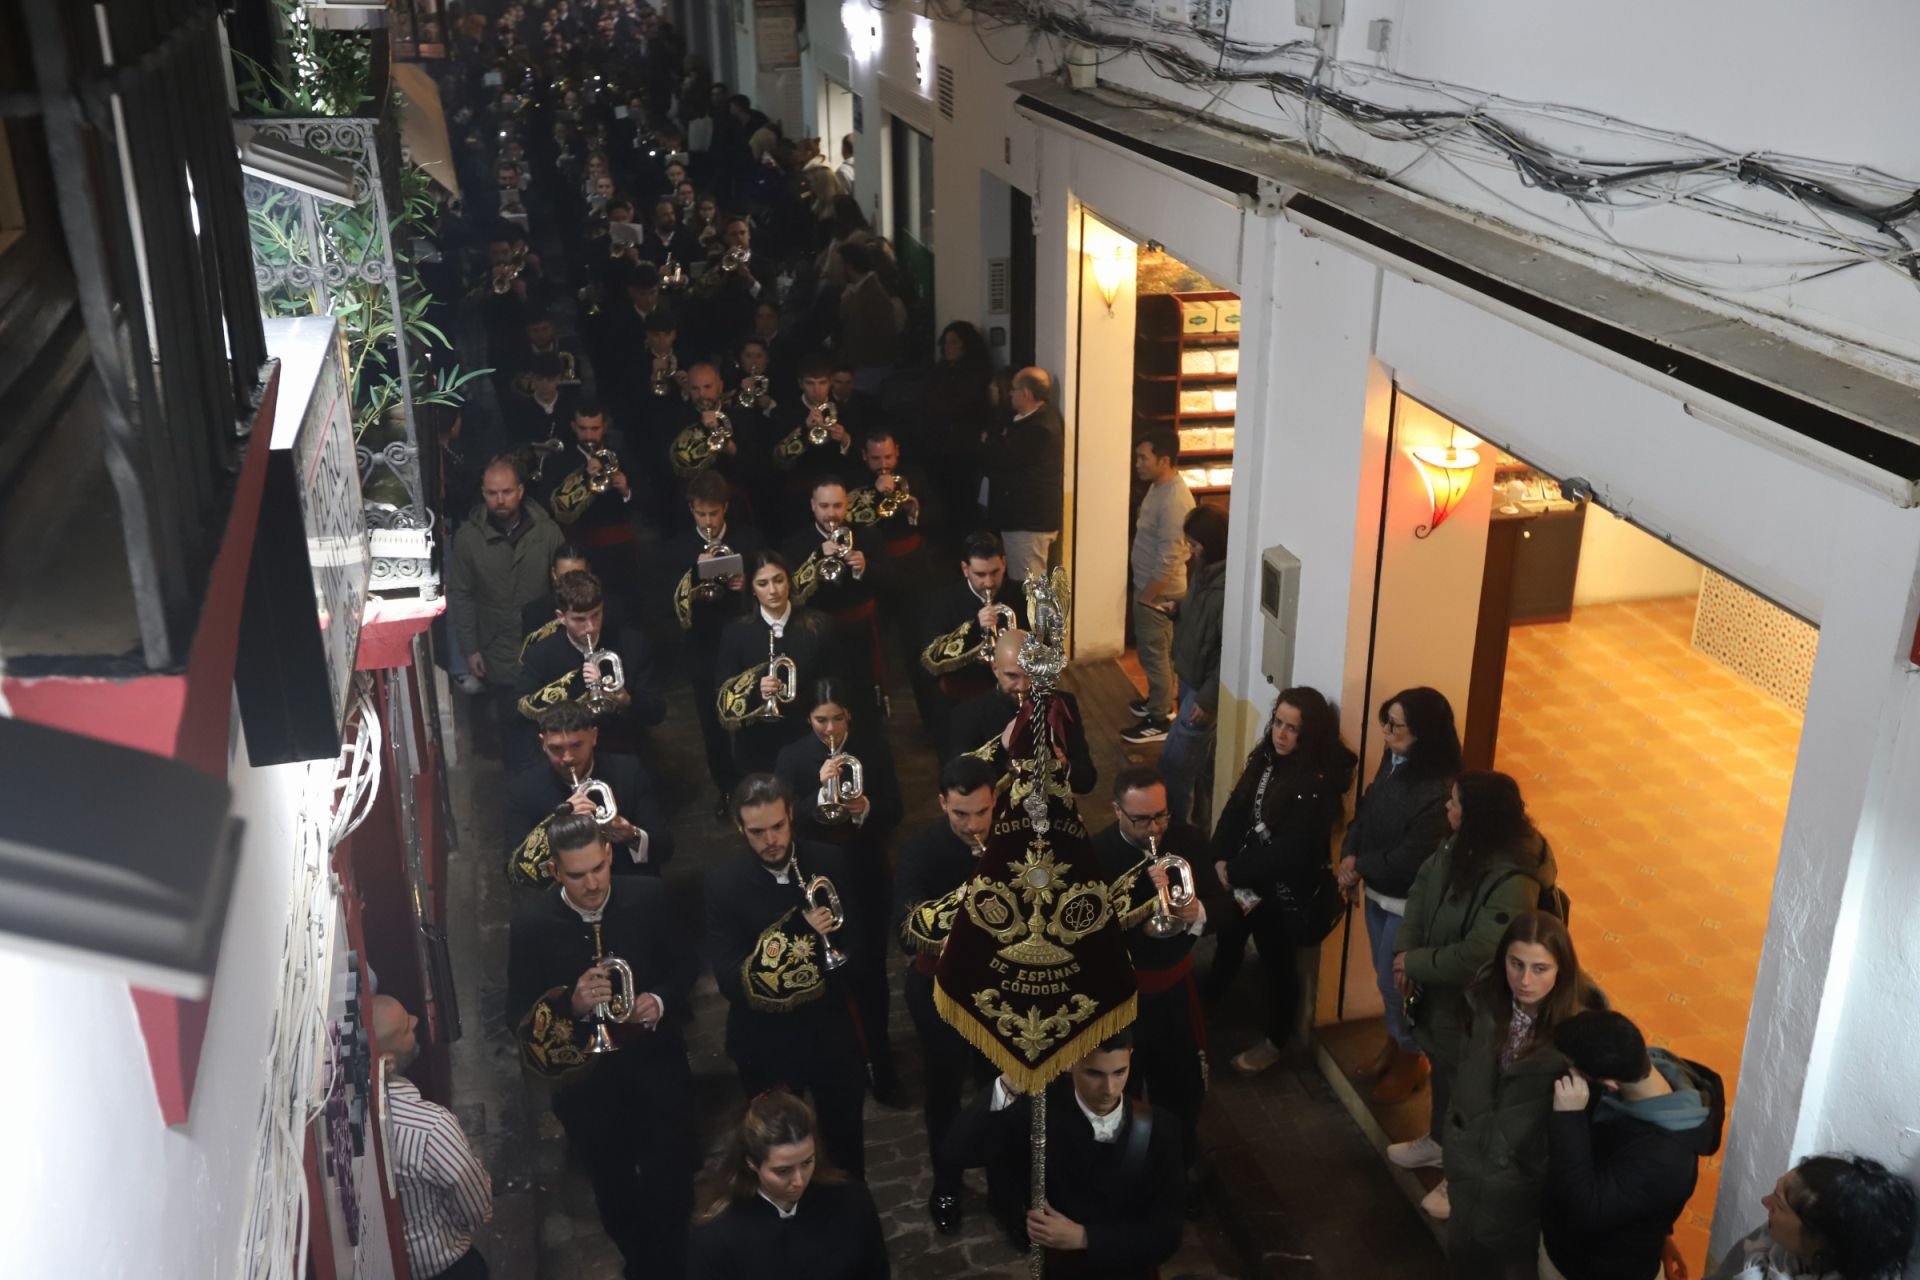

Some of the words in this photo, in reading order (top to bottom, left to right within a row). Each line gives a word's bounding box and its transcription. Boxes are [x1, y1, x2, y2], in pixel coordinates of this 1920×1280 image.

[312, 421, 340, 549] PEDRO
[995, 817, 1087, 839] COROCIÓN
[989, 958, 1009, 974] DE
[1001, 980, 1070, 995] CÓRDOBA
